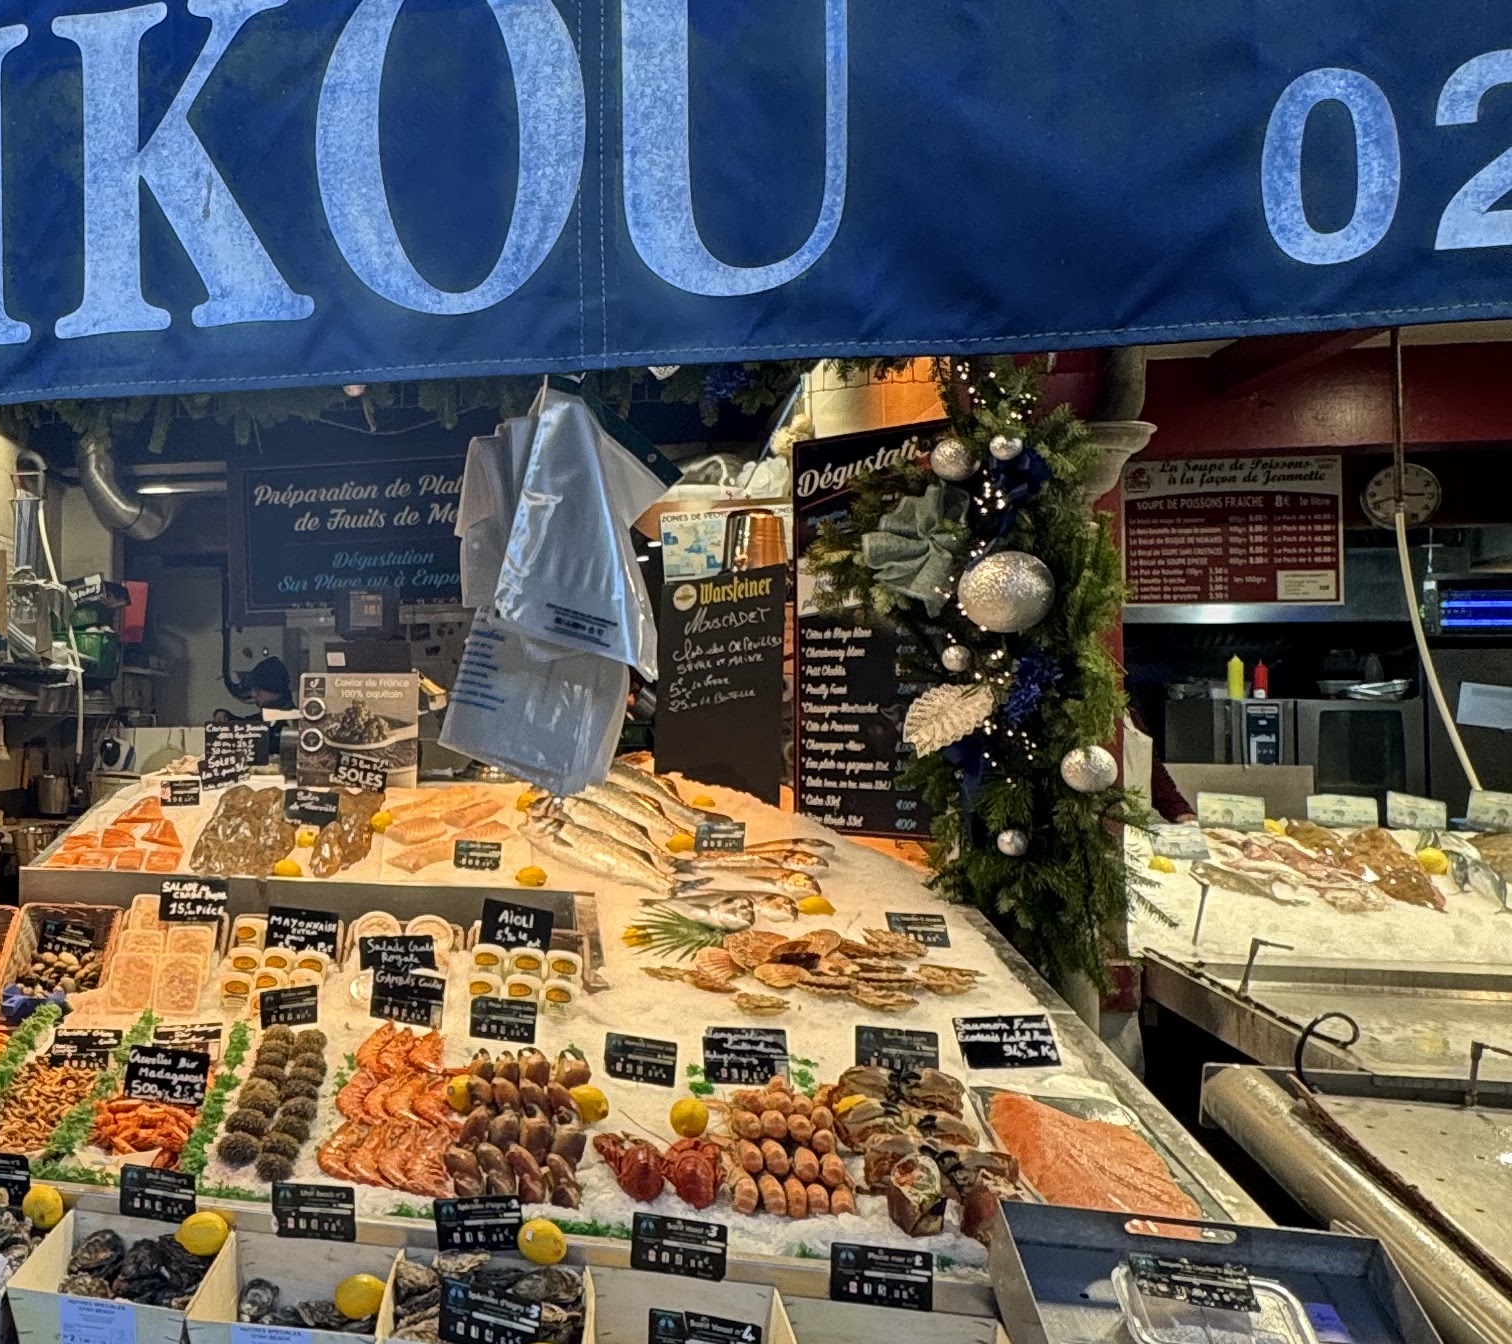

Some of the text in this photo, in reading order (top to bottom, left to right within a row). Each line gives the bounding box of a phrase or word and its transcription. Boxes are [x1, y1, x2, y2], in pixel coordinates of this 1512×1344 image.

[1261, 49, 1512, 265] 02
[1159, 461, 1178, 473] La
[1183, 460, 1228, 474] Soupe
[1229, 460, 1246, 472] de
[1199, 471, 1236, 490] façon
[1242, 471, 1259, 483] de
[1262, 471, 1326, 487] Jeannette
[254, 481, 379, 508] Préparation
[385, 477, 412, 498] de
[1137, 501, 1165, 510] SOUPE
[1167, 500, 1178, 509] DE
[1180, 497, 1223, 508] POISSONS
[294, 512, 321, 532] de
[327, 508, 386, 530] Fruits
[393, 506, 420, 526] de
[332, 550, 434, 572] Dégustation
[700, 577, 772, 605] Warsteiner
[334, 679, 410, 688] Caviar de France
[341, 690, 364, 699] 100%
[338, 766, 383, 788] SOLES
[955, 1018, 1010, 1031] Saumon
